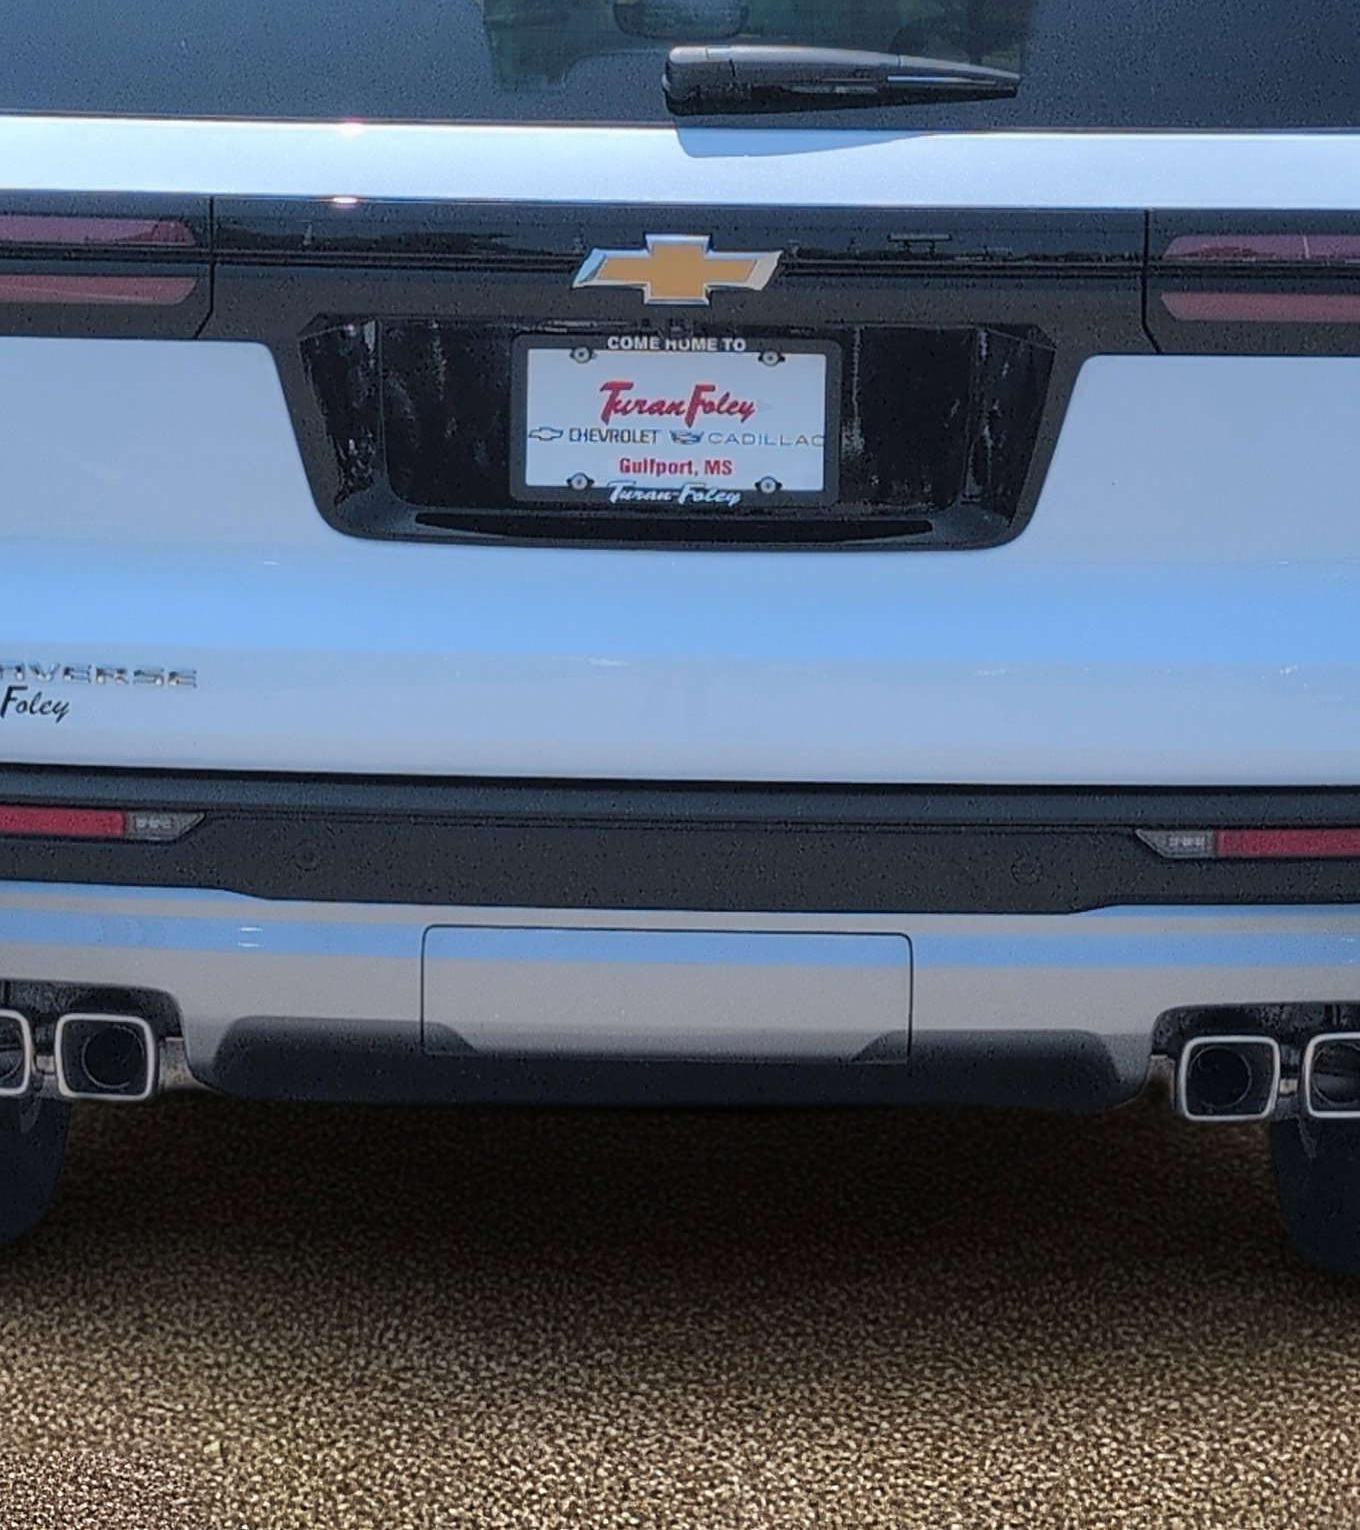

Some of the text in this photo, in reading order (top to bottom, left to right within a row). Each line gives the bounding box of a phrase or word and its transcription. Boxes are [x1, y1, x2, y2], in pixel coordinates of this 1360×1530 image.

[607, 336, 746, 352] COME HOME TO
[569, 428, 825, 447] CHEVROLET CADILLAC
[619, 458, 733, 477] Gulfport, MS
